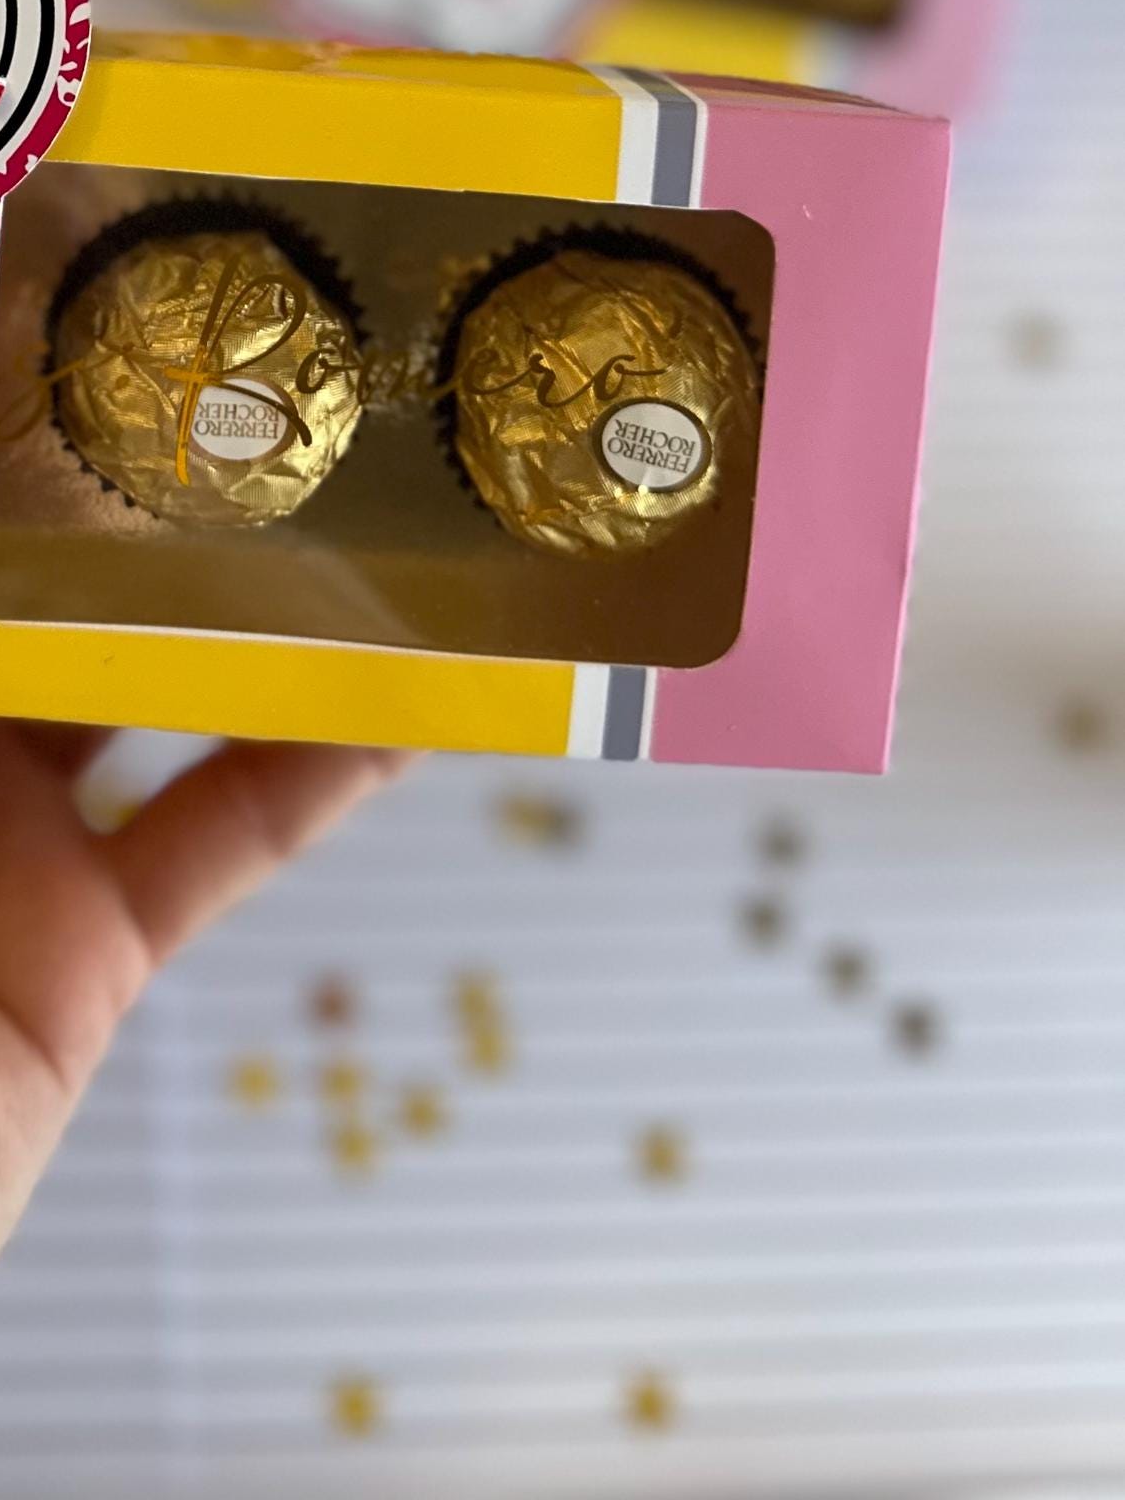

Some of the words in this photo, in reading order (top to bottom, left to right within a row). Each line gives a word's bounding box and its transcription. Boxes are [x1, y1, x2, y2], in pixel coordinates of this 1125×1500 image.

[197, 401, 279, 422] ROCHER
[194, 419, 279, 440] FERRERO
[614, 418, 697, 457] ROCHER
[606, 436, 692, 474] FERRERO
